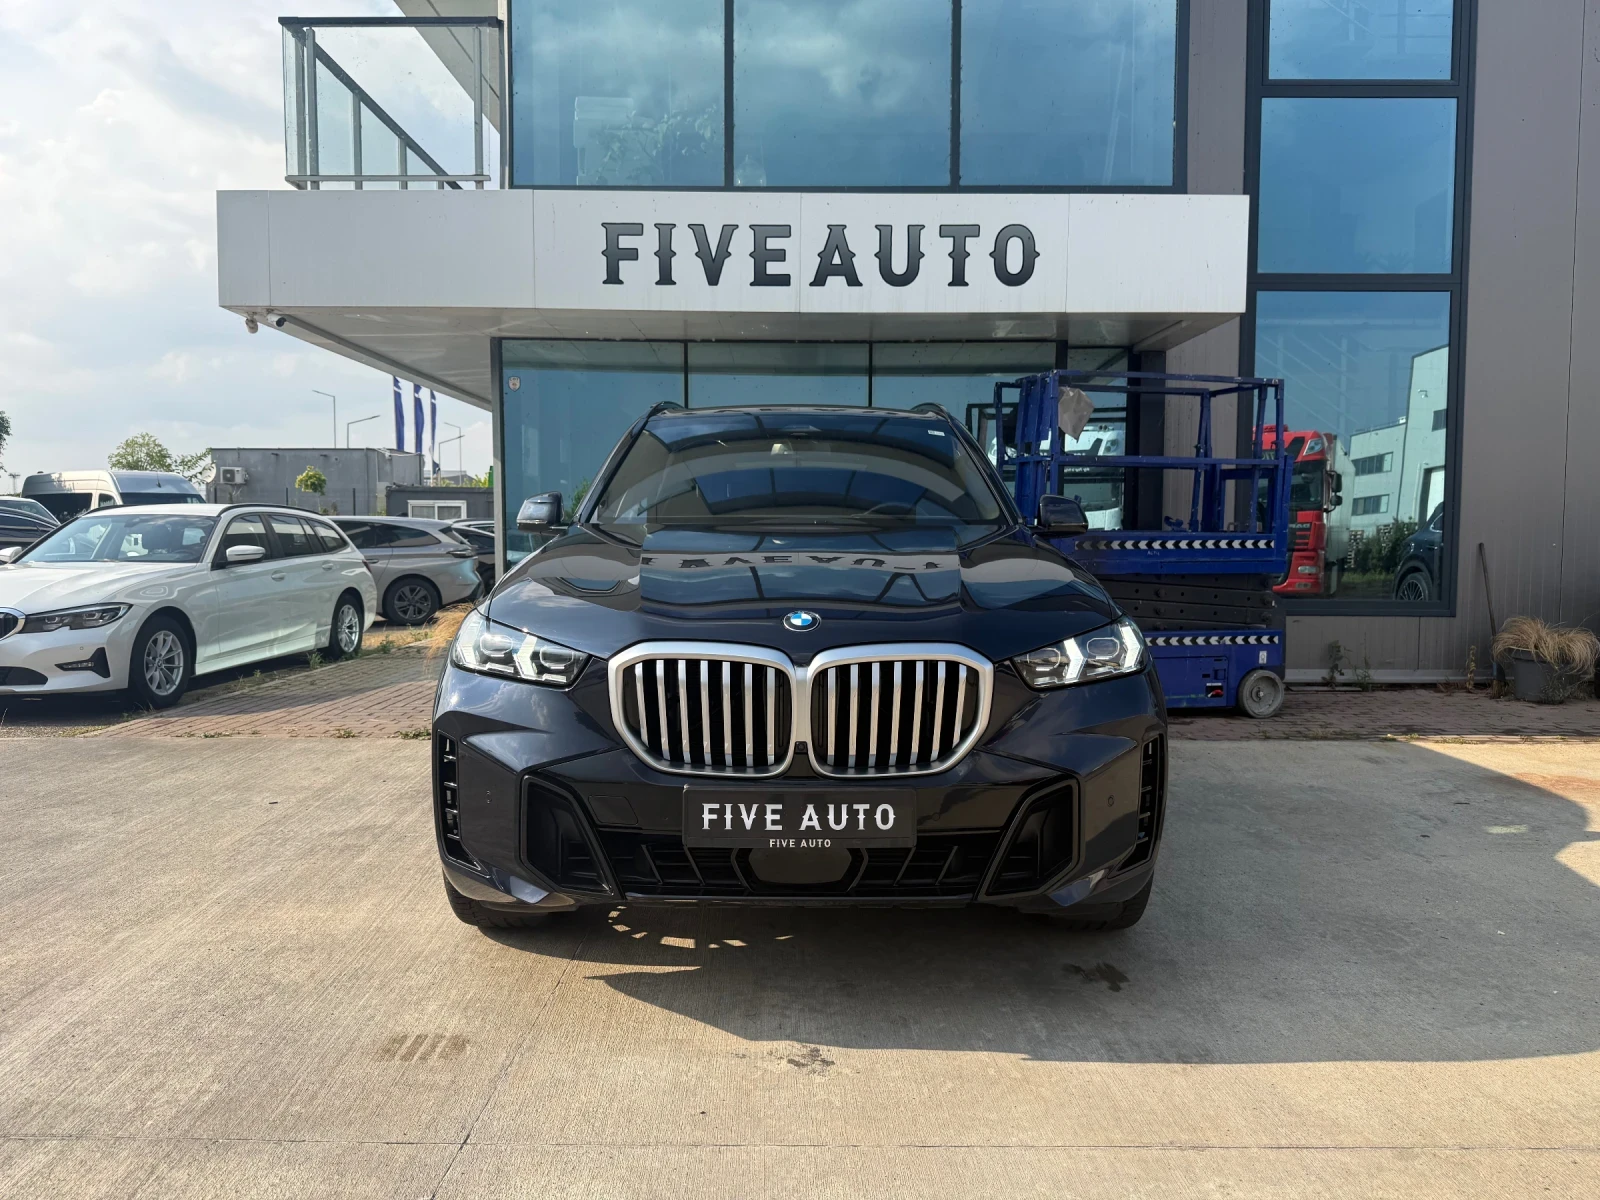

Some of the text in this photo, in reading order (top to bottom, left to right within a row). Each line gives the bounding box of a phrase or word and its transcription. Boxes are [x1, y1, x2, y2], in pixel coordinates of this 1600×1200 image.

[701, 803, 897, 830] FIVE AUTO
[769, 839, 832, 848] FIVE AUTO
